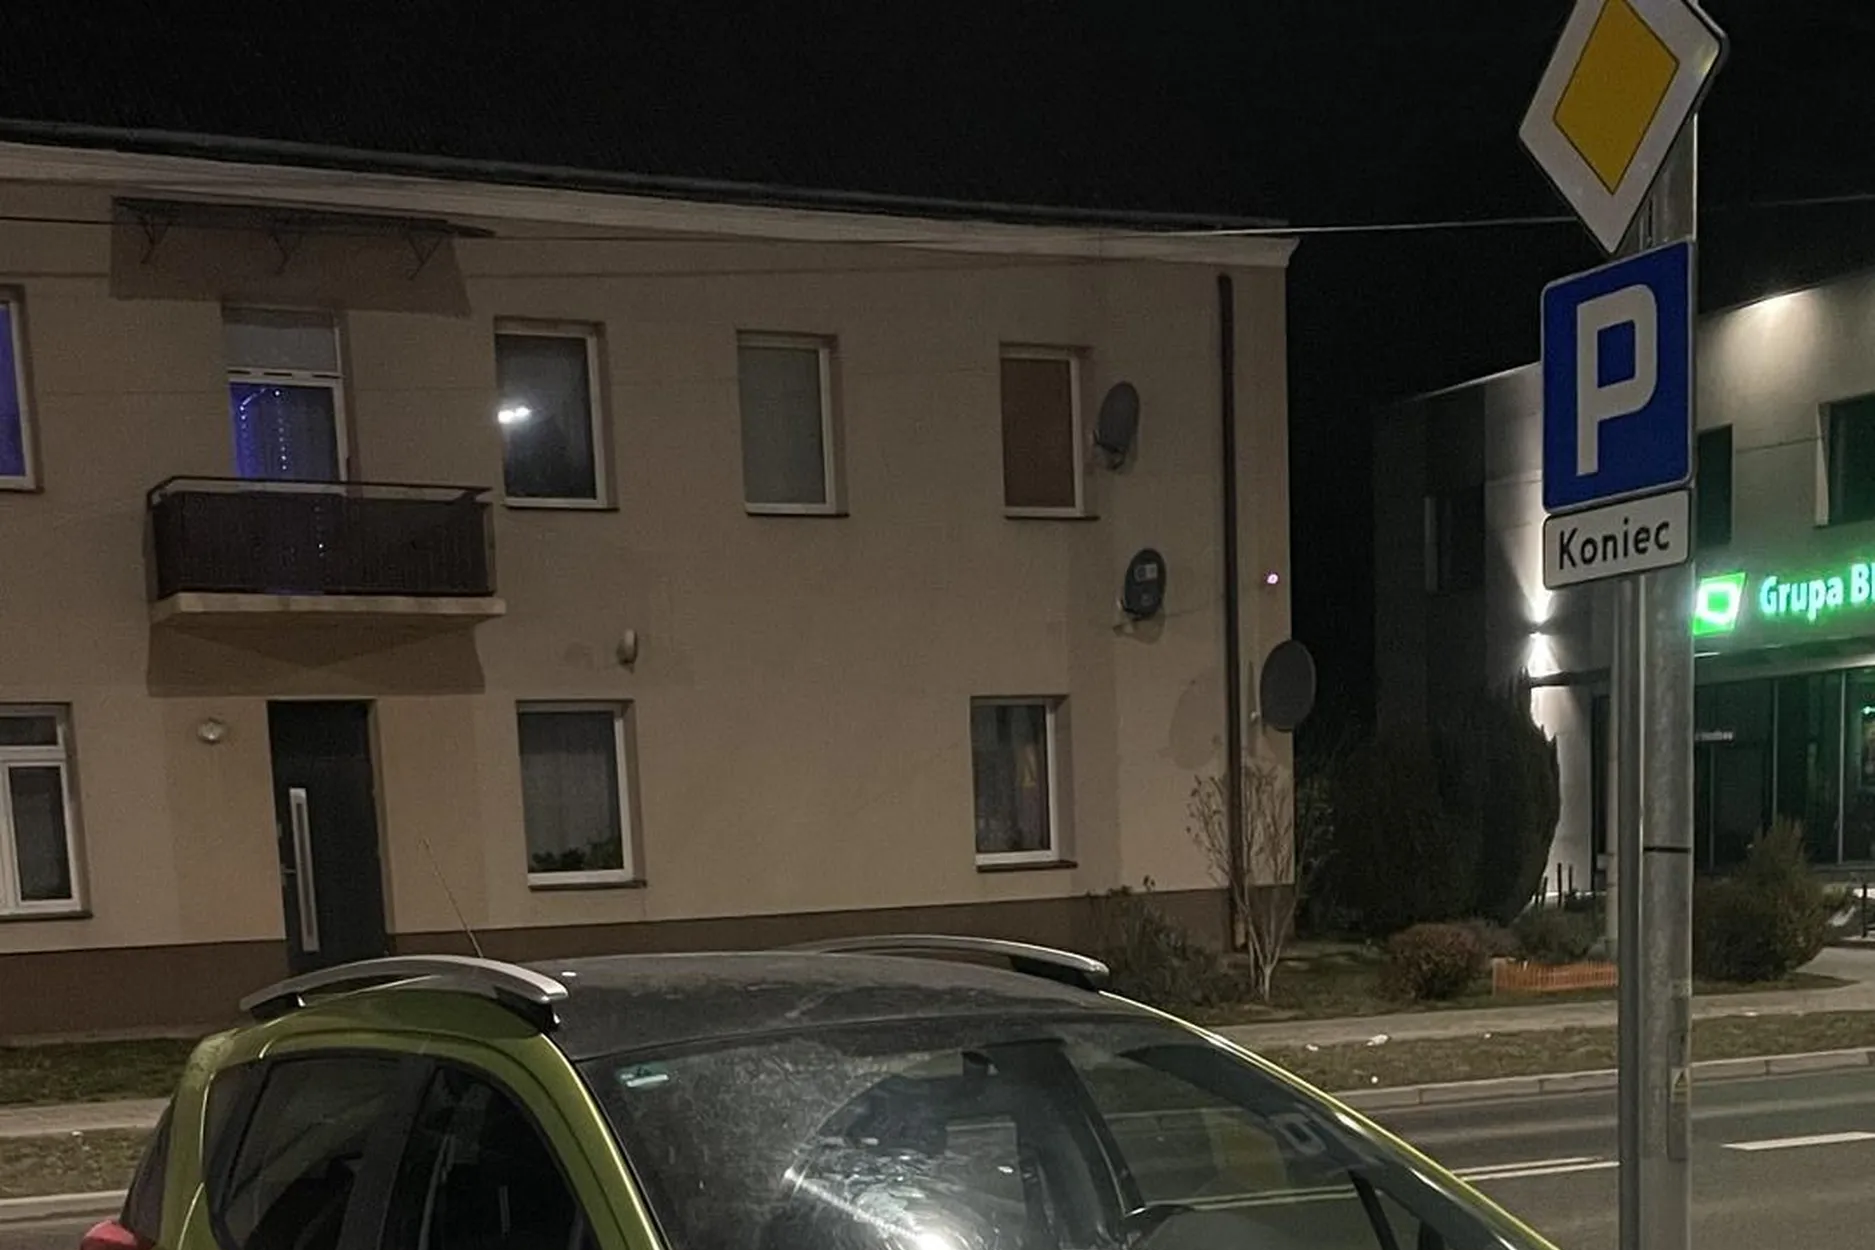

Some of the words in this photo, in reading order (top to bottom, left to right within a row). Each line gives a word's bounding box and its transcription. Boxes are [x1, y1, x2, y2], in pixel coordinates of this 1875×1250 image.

[1576, 283, 1658, 477] P
[1559, 516, 1670, 570] Koniec
[1759, 575, 1844, 623] Grupa
[1849, 561, 1875, 604] B
